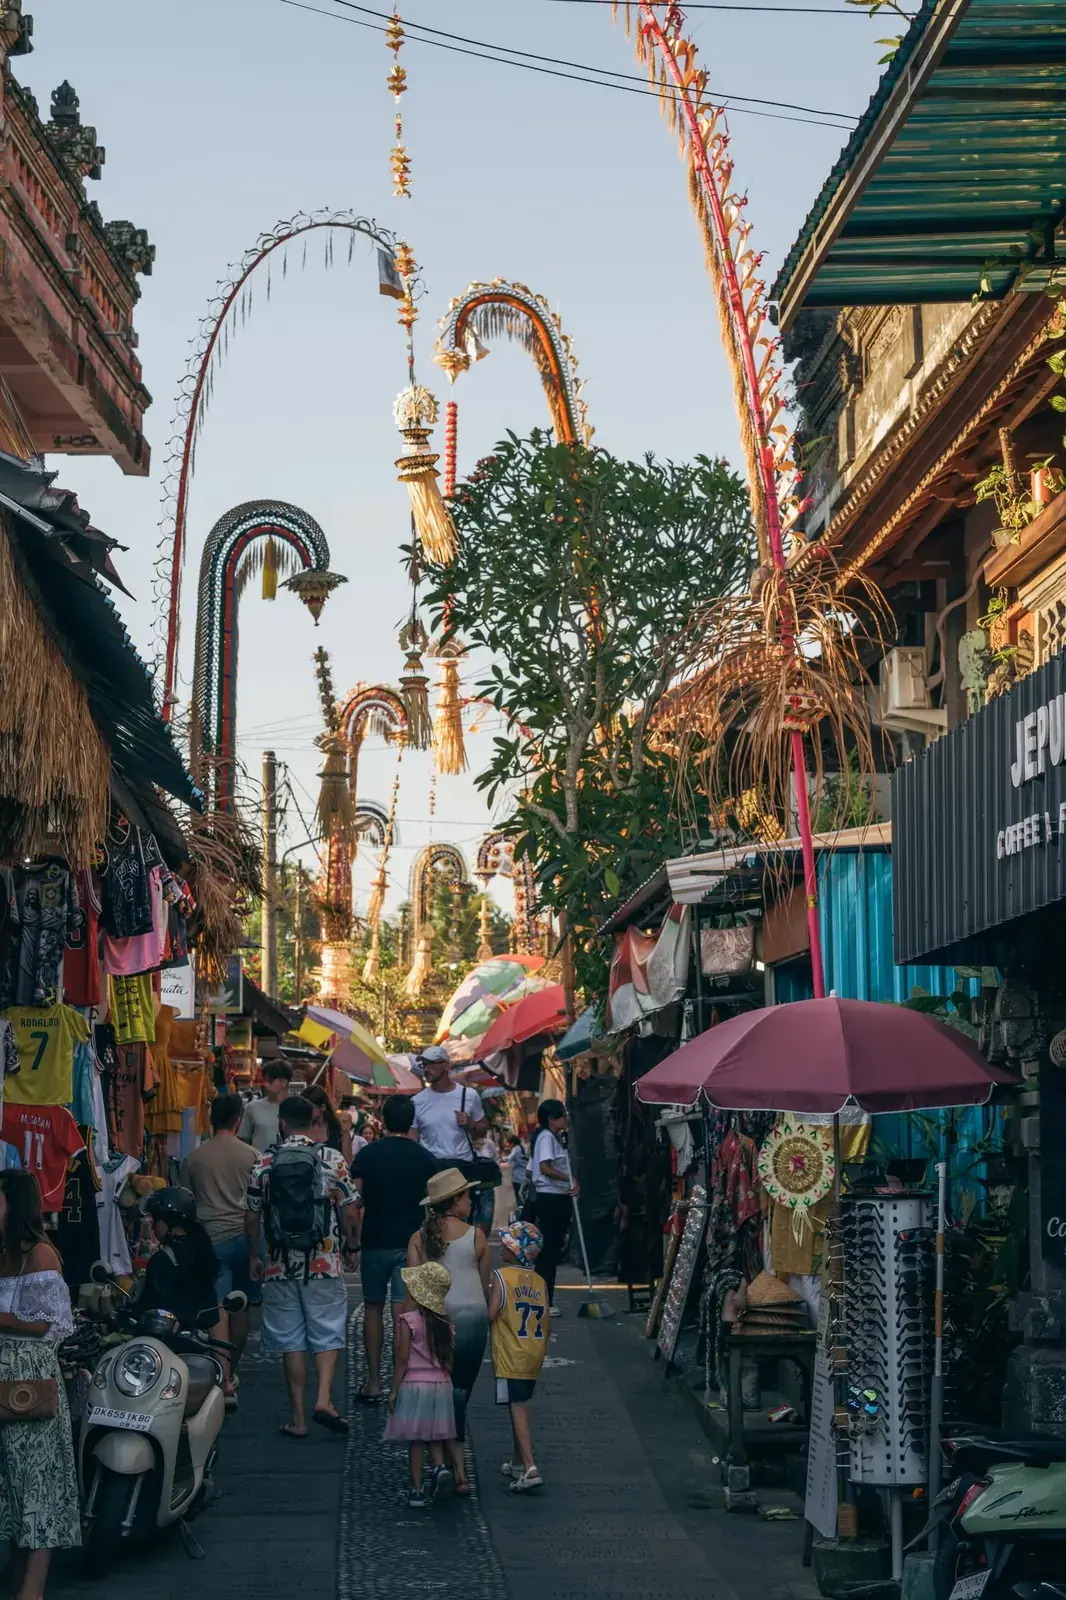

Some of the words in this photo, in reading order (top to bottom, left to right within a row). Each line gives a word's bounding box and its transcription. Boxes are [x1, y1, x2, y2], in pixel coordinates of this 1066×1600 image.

[1011, 692, 1066, 788] JEPU
[996, 813, 1040, 860] COFFEE
[20, 1018, 59, 1028] RONALDO
[30, 1031, 49, 1070] 7
[23, 1130, 45, 1170] 11
[513, 1301, 545, 1339] 77
